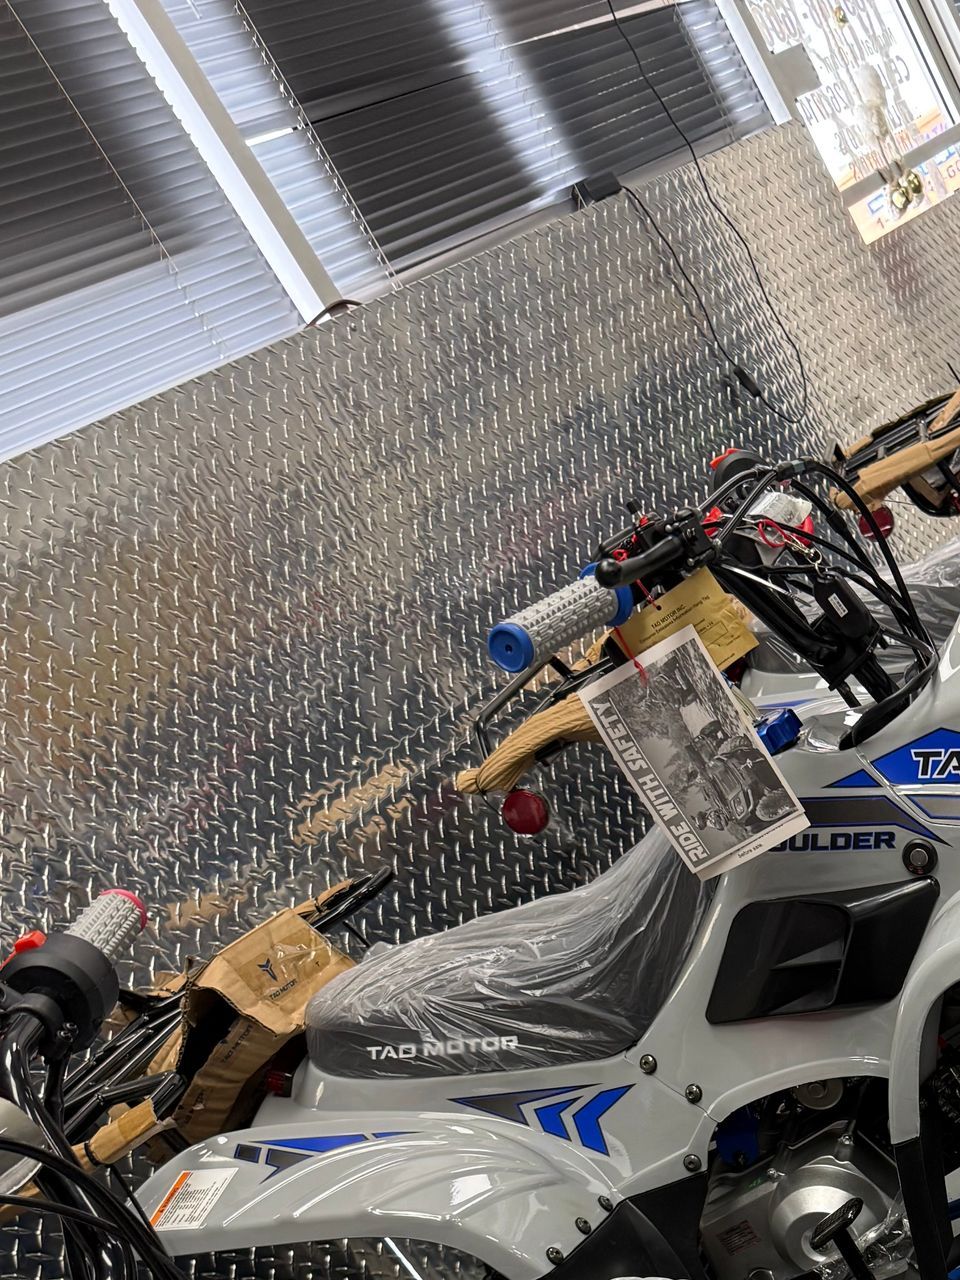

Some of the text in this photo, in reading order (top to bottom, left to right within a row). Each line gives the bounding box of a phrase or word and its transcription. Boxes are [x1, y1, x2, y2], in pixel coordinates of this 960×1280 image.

[592, 702, 708, 862] RIDE WITH SAFETY
[367, 1035, 518, 1063] TAO MOTOR
